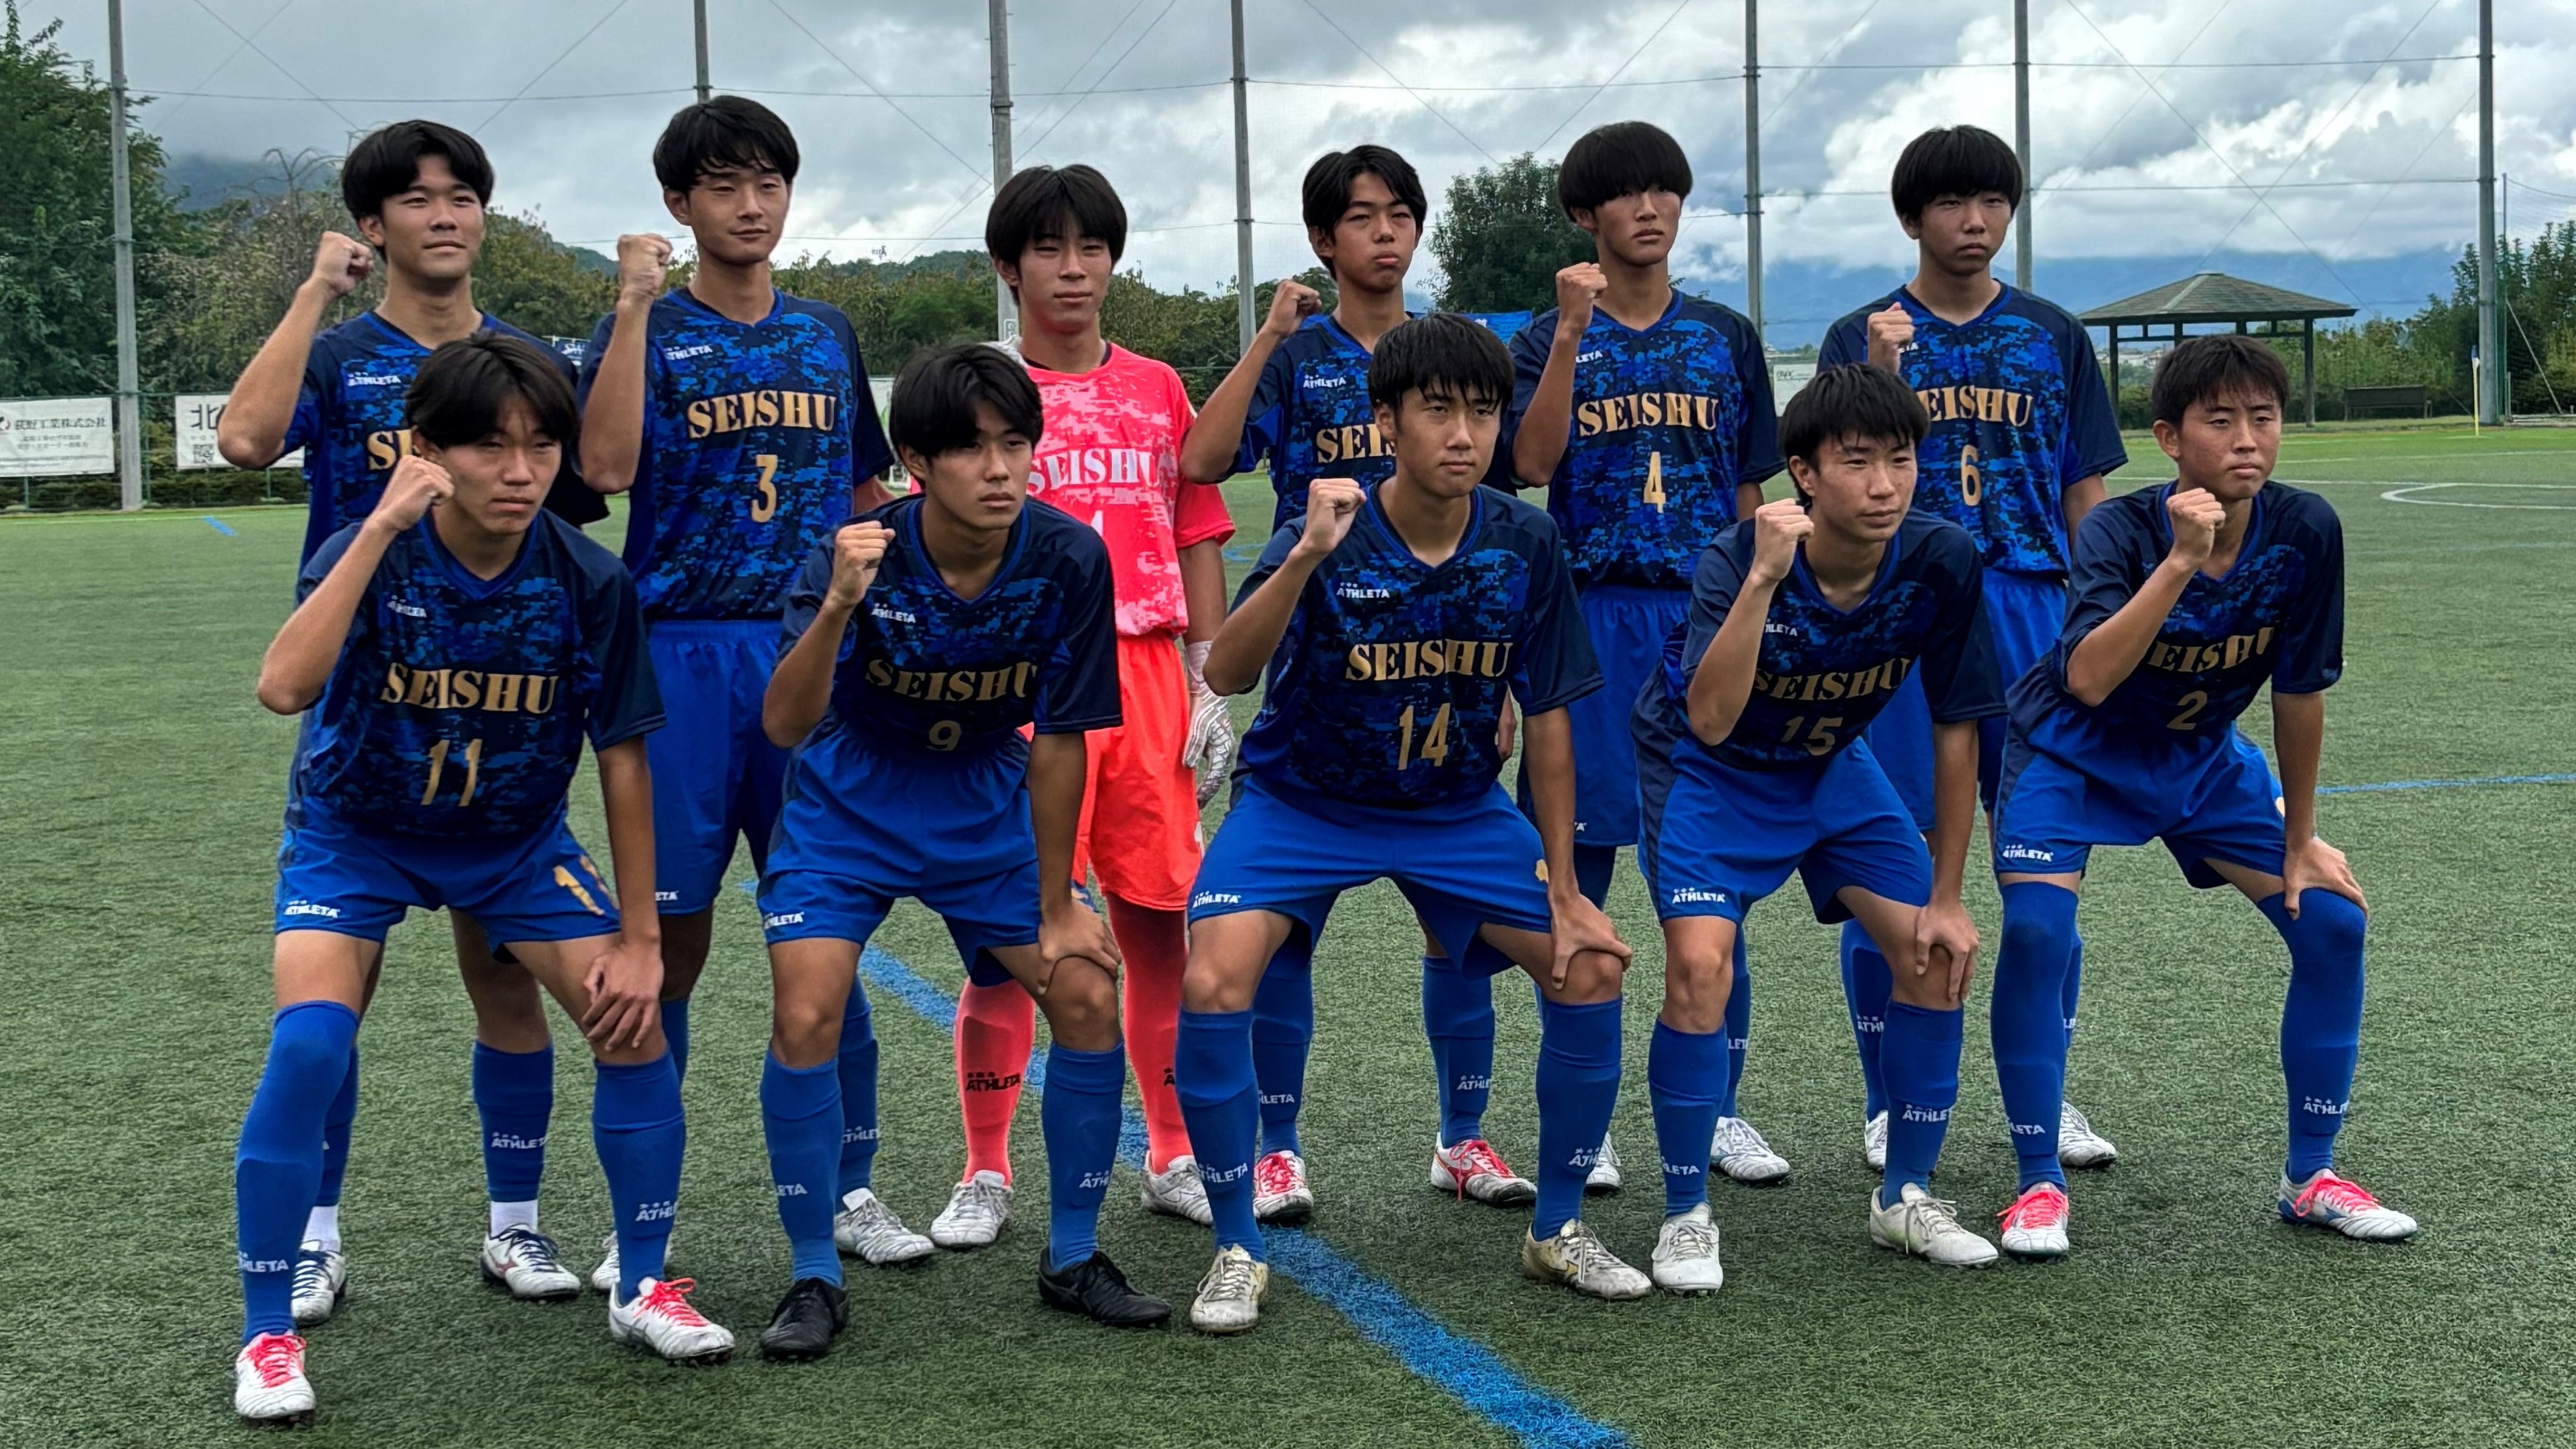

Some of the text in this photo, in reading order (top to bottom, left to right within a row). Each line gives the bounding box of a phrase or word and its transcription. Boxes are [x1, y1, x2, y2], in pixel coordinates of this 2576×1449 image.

[1575, 350, 1603, 363] LETA
[1303, 377, 1347, 389] ATHLETA
[687, 389, 837, 438] SEISHU
[1577, 393, 1719, 436] SEISHU
[1916, 385, 2033, 427] EISHU
[1316, 423, 1396, 464] SEI
[751, 454, 779, 522] 3
[1026, 448, 1161, 495] SEISHU
[1643, 451, 1666, 513] 4
[1961, 444, 1982, 506] 6
[1336, 587, 1390, 598] ATHLETA
[871, 608, 916, 623] ATHLETA
[1345, 638, 1514, 681] SEISHU
[1754, 658, 1910, 700] SEISHU
[379, 662, 559, 713] SEISHU
[865, 659, 1038, 701] SEISHU
[2166, 690, 2208, 730] 2
[926, 719, 962, 751] 9
[1397, 702, 1451, 771] 14
[1780, 716, 1843, 757] 15
[420, 738, 483, 807] 11
[2003, 849, 2052, 862] ATHLETA
[284, 904, 338, 918] ATHLETA
[1672, 892, 1725, 904] ATHLETA
[965, 1073, 1020, 1092] ATHLETA
[1902, 1109, 1950, 1122] ATHLE
[2010, 1122, 2046, 1135] LETA
[1662, 1163, 1699, 1175] LETA
[635, 1205, 675, 1222] ATHL
[240, 1260, 289, 1273] LETA
